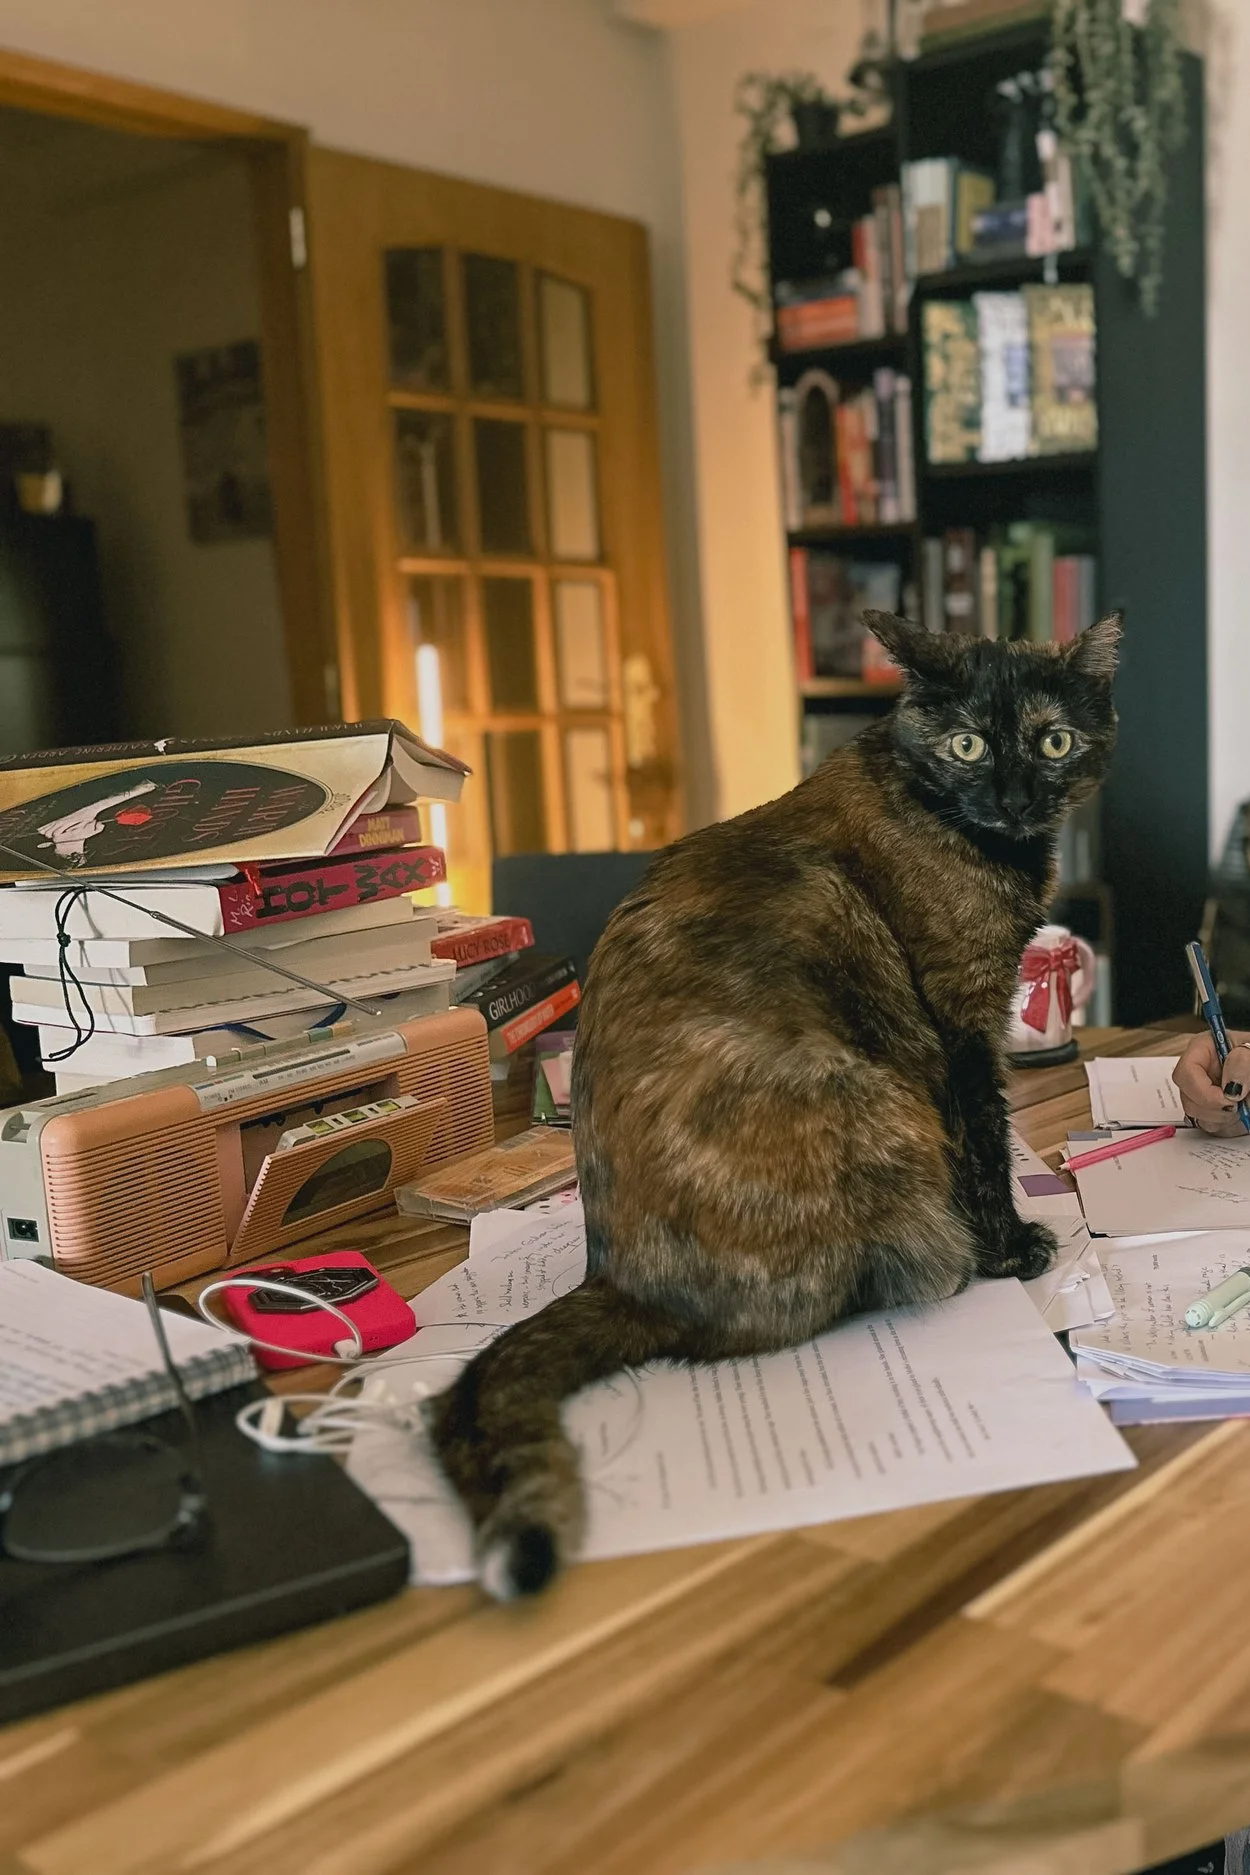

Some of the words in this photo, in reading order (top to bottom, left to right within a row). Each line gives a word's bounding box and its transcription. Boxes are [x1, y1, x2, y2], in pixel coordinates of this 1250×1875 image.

[367, 815, 391, 830] MATT
[255, 878, 349, 919] HOT
[353, 857, 427, 903] WAX
[452, 940, 483, 961] LUCY
[483, 932, 511, 954] ROSE
